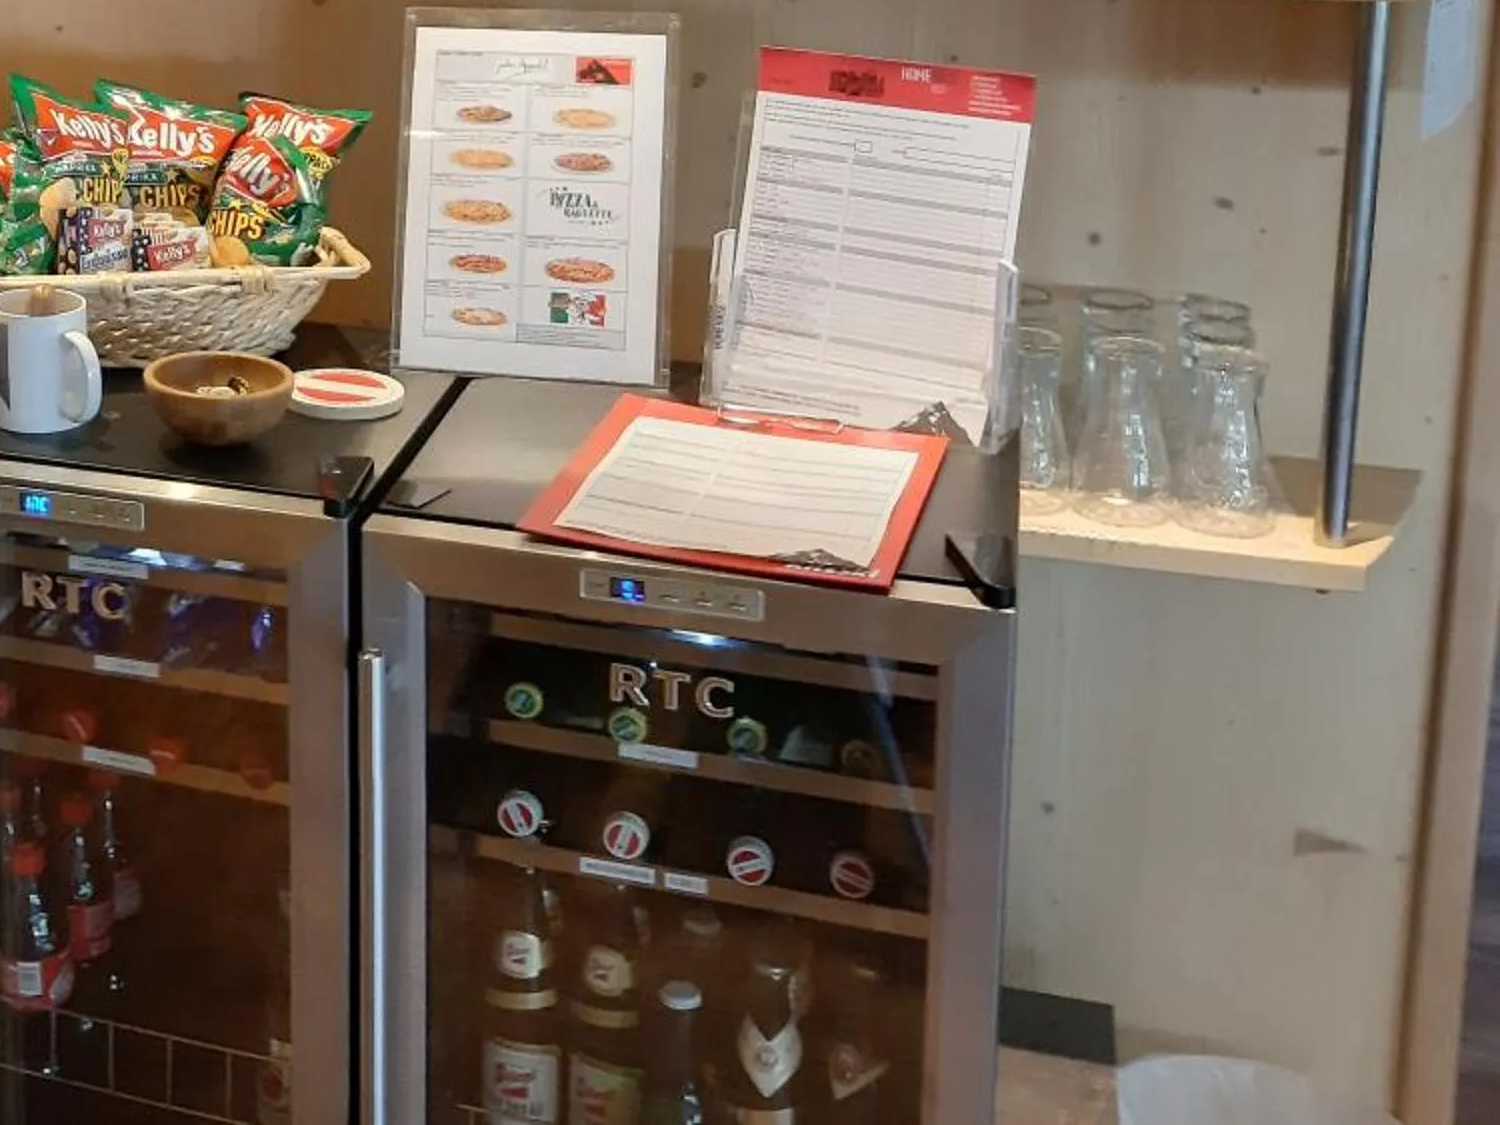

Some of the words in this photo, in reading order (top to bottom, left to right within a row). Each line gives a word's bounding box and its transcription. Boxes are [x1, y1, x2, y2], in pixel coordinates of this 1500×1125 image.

[900, 65, 933, 83] HOME
[49, 108, 125, 150] Kelly's
[128, 120, 215, 157] Kelly's
[253, 112, 329, 146] Kelly's
[83, 177, 122, 204] CHIP
[139, 183, 201, 209] CHIPS
[153, 243, 192, 262] Kelly's
[20, 571, 129, 620] RTC
[609, 661, 736, 719] RTC
